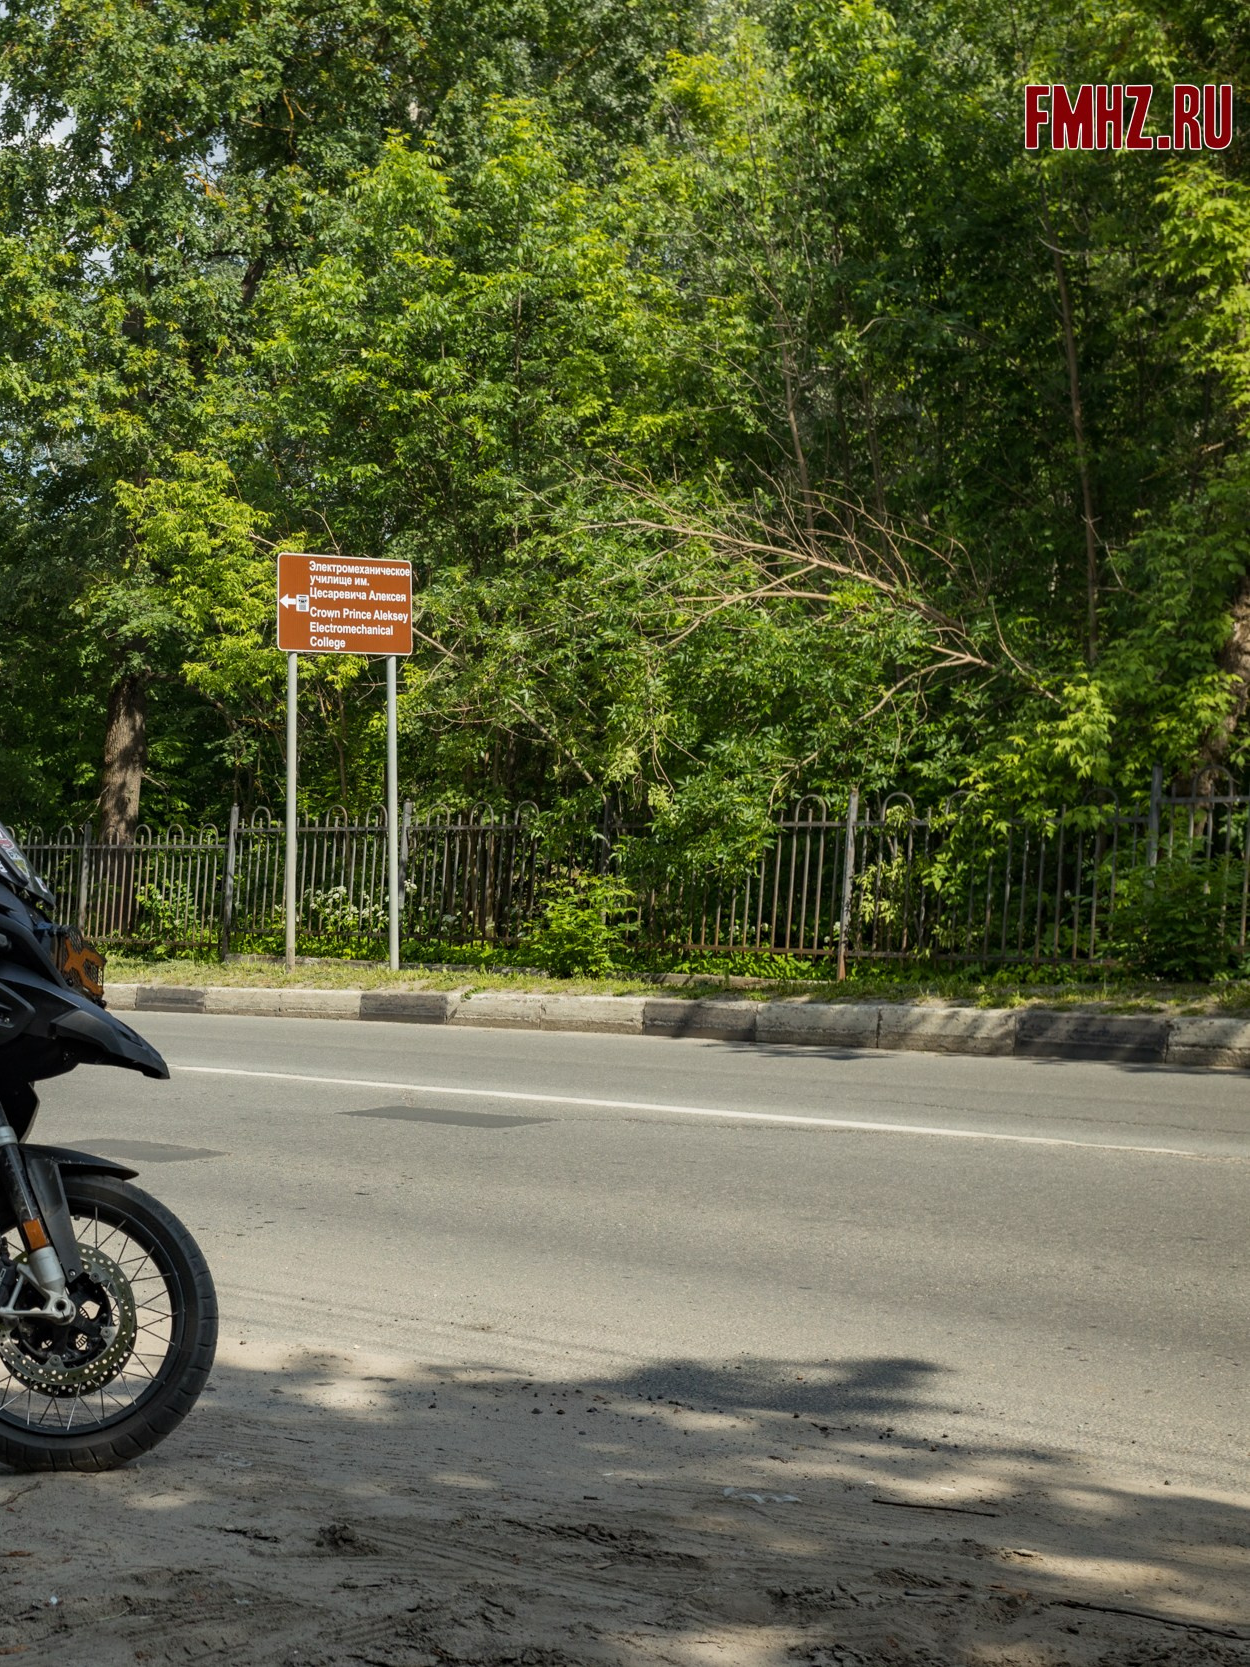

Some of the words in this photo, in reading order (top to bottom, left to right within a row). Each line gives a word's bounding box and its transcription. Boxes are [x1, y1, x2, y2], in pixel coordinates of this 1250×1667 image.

[309, 561, 410, 576] Электромеханическое
[310, 575, 352, 586] училище
[354, 577, 370, 586] им.
[310, 587, 367, 601] Цесаревича
[369, 590, 406, 602] Алексея
[310, 606, 340, 618] Crown
[343, 608, 372, 620] Prince
[373, 609, 408, 623] Aleksey
[310, 622, 393, 635] Electromechanical
[310, 636, 346, 650] College
